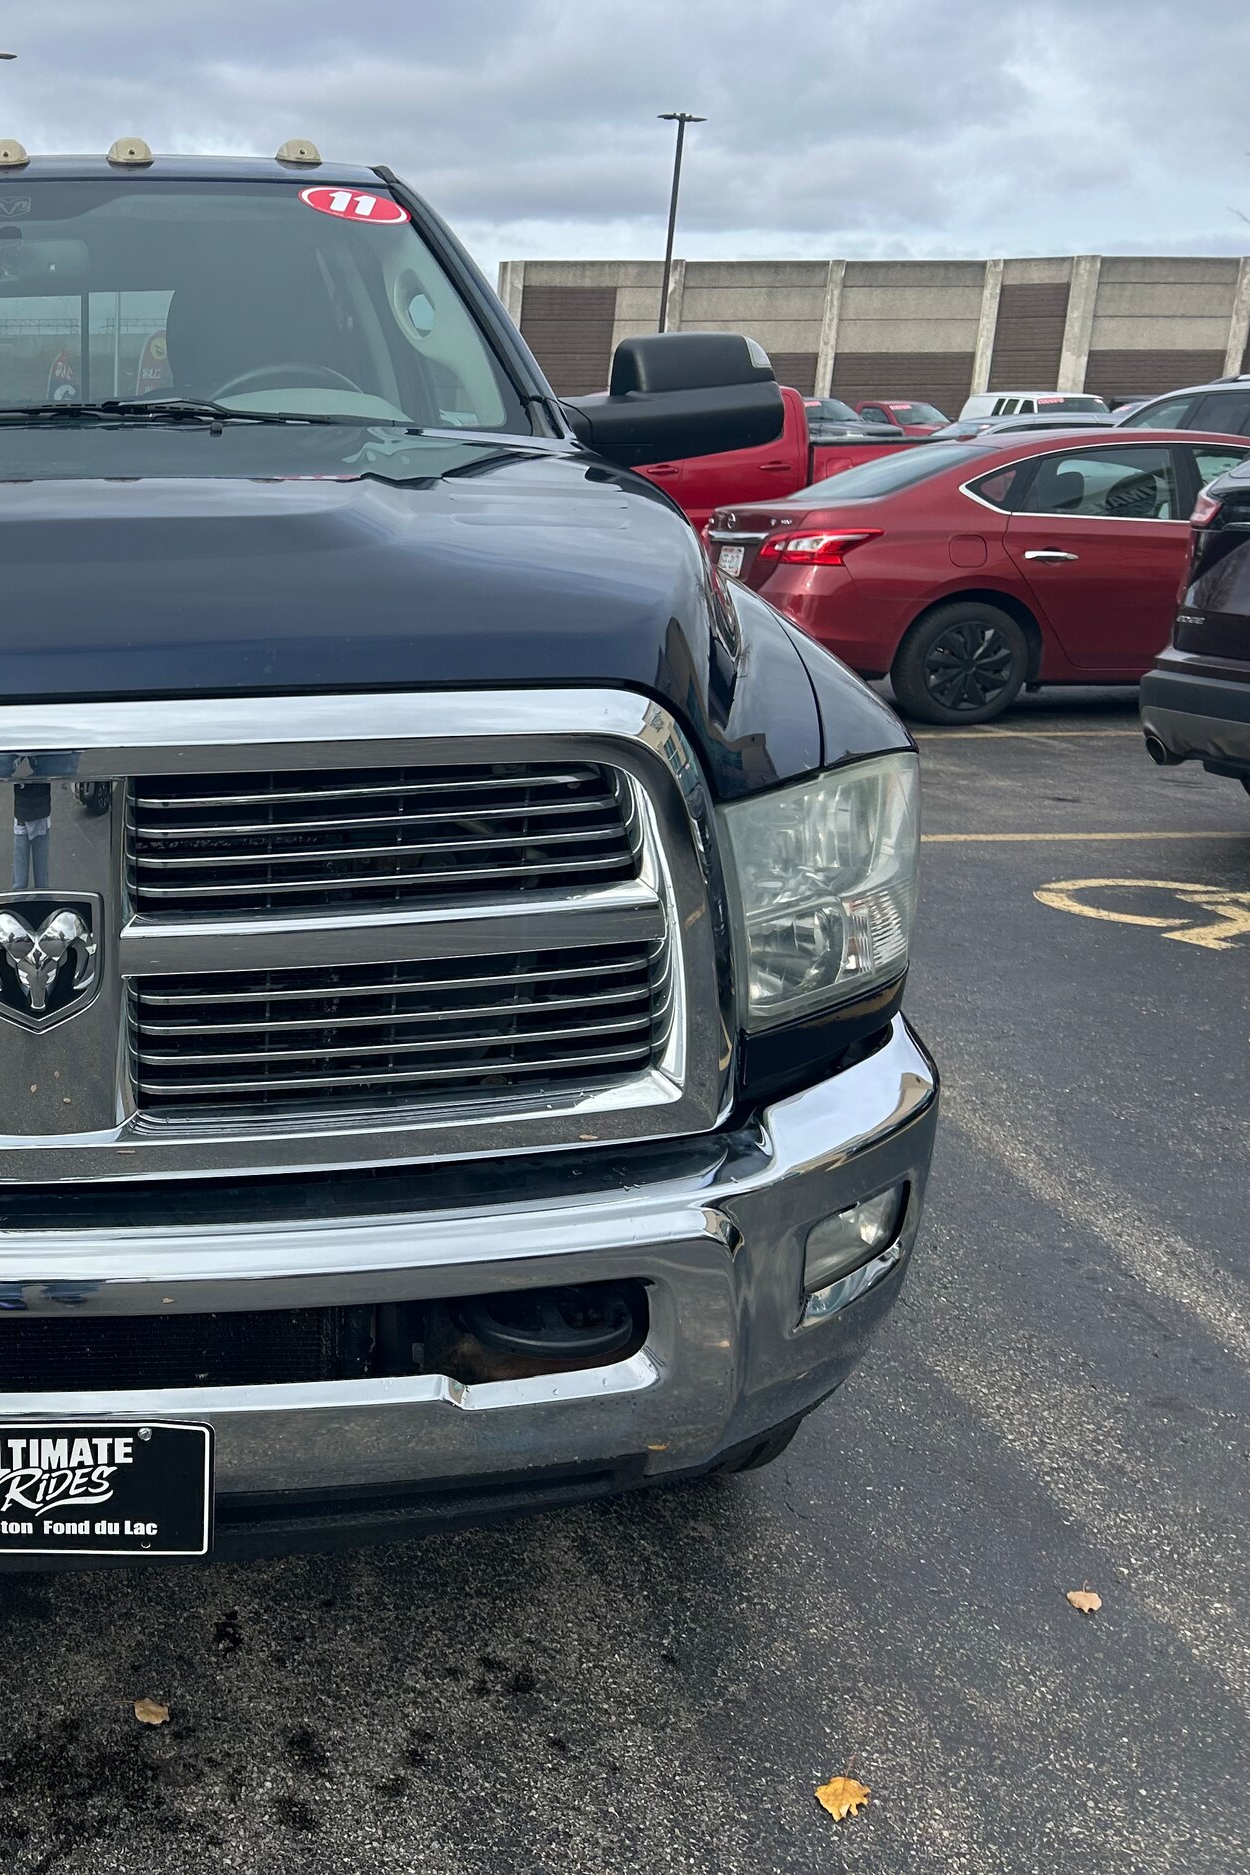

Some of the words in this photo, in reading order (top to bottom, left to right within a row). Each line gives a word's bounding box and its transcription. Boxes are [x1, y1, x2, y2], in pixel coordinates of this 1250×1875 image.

[329, 191, 377, 217] 11
[43, 1520, 90, 1535] Fond
[94, 1519, 121, 1535] du
[124, 1520, 158, 1536] Lac
